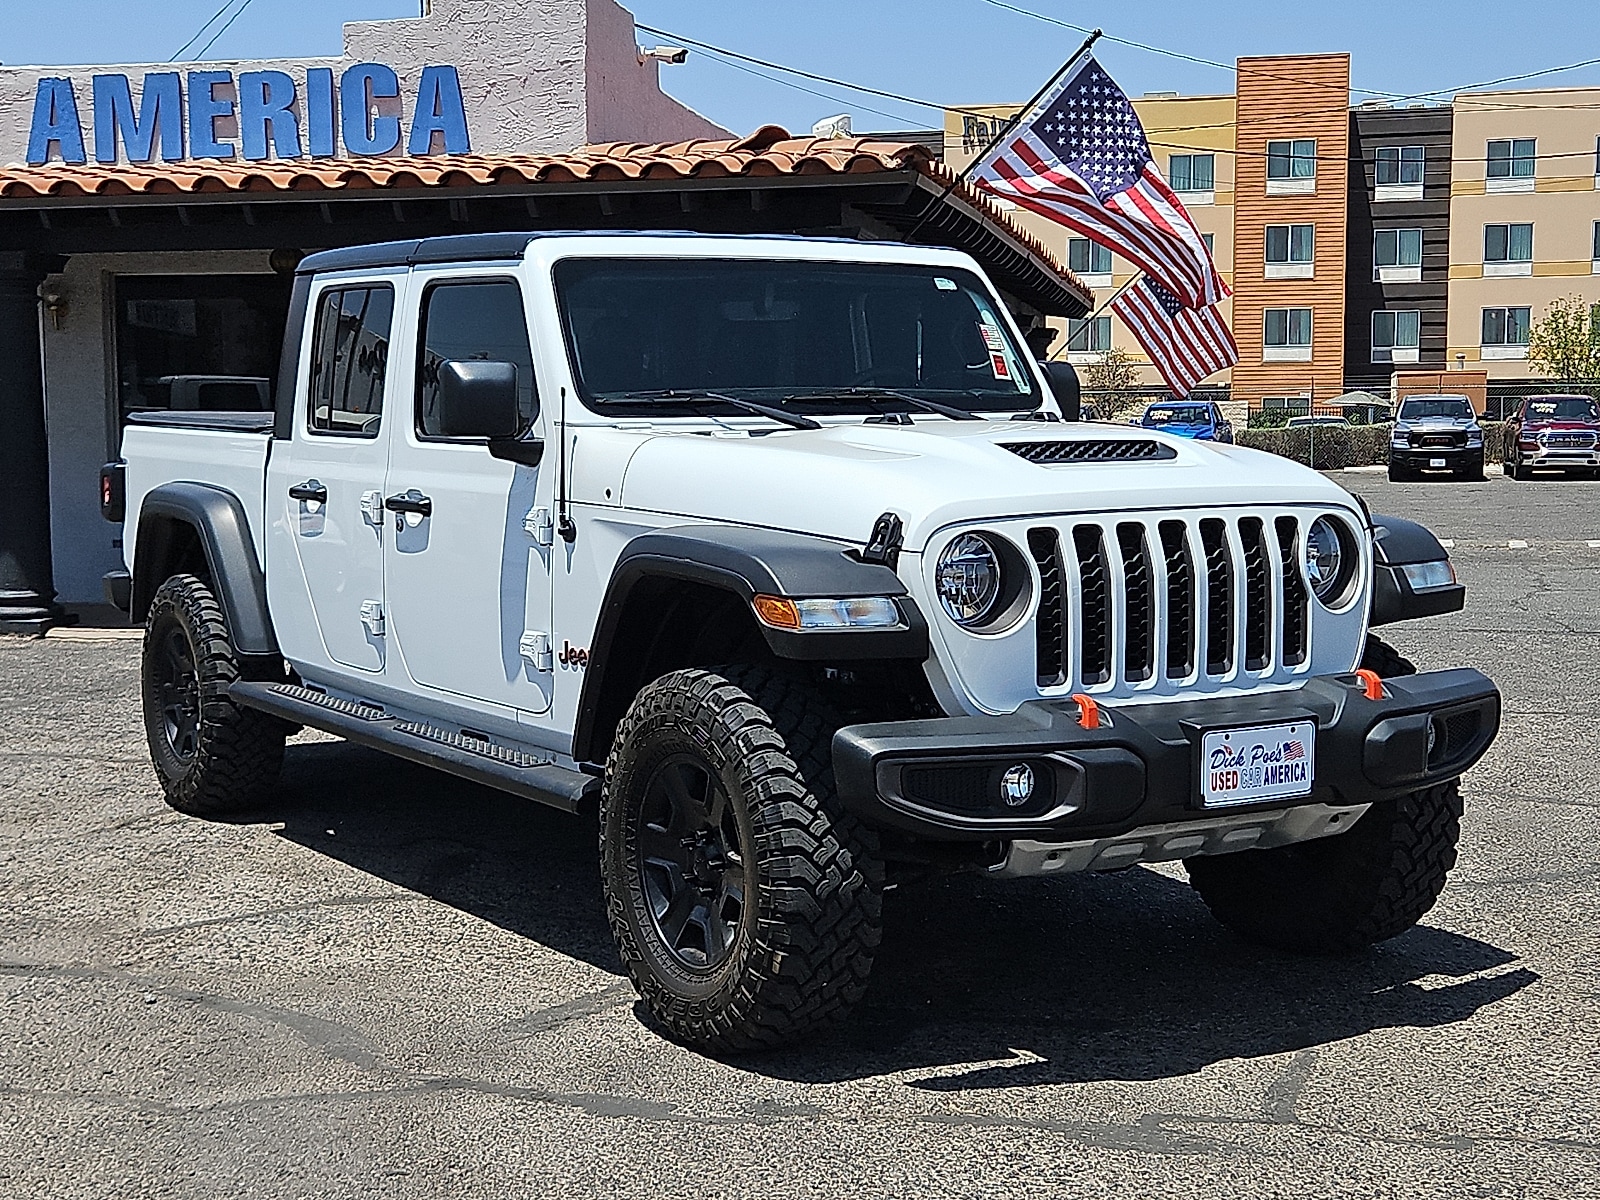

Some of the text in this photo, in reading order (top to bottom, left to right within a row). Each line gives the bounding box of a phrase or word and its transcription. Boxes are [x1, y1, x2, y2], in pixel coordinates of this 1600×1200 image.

[26, 63, 471, 165] AMERICA
[558, 640, 590, 668] Jee
[1210, 741, 1283, 770] Dick Poe's
[1210, 762, 1308, 792] USED CAR AMERICA
